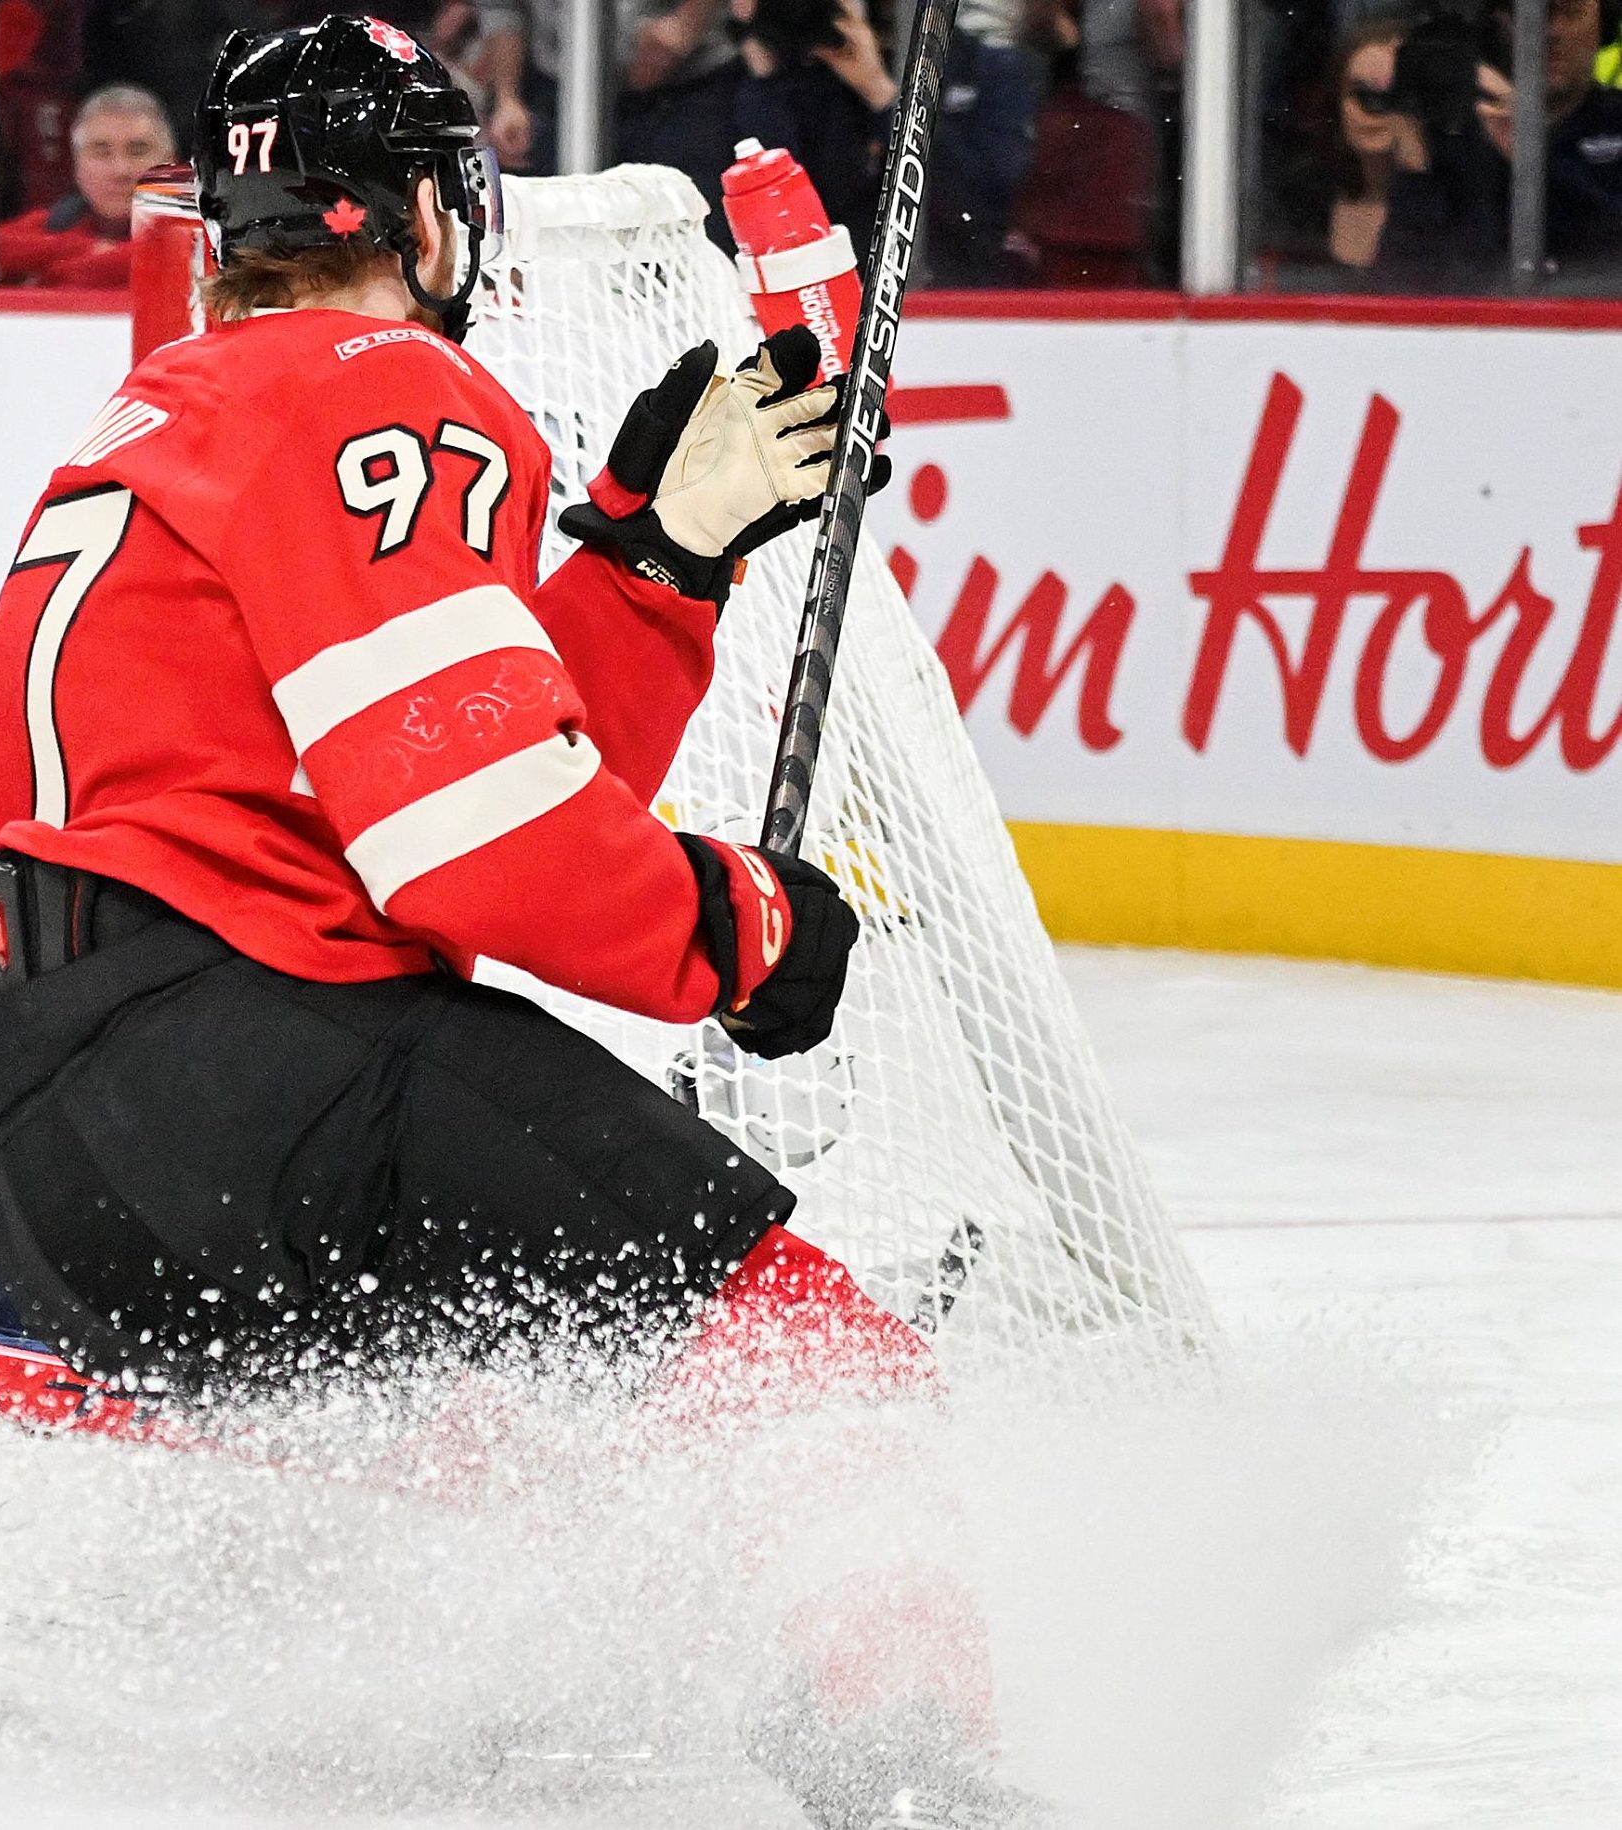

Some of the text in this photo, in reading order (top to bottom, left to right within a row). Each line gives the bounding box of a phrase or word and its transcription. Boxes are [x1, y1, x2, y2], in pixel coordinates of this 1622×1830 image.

[227, 121, 277, 176] 97
[847, 153, 925, 483] JETSPEED
[905, 102, 928, 155] FTS
[335, 418, 510, 564] 97
